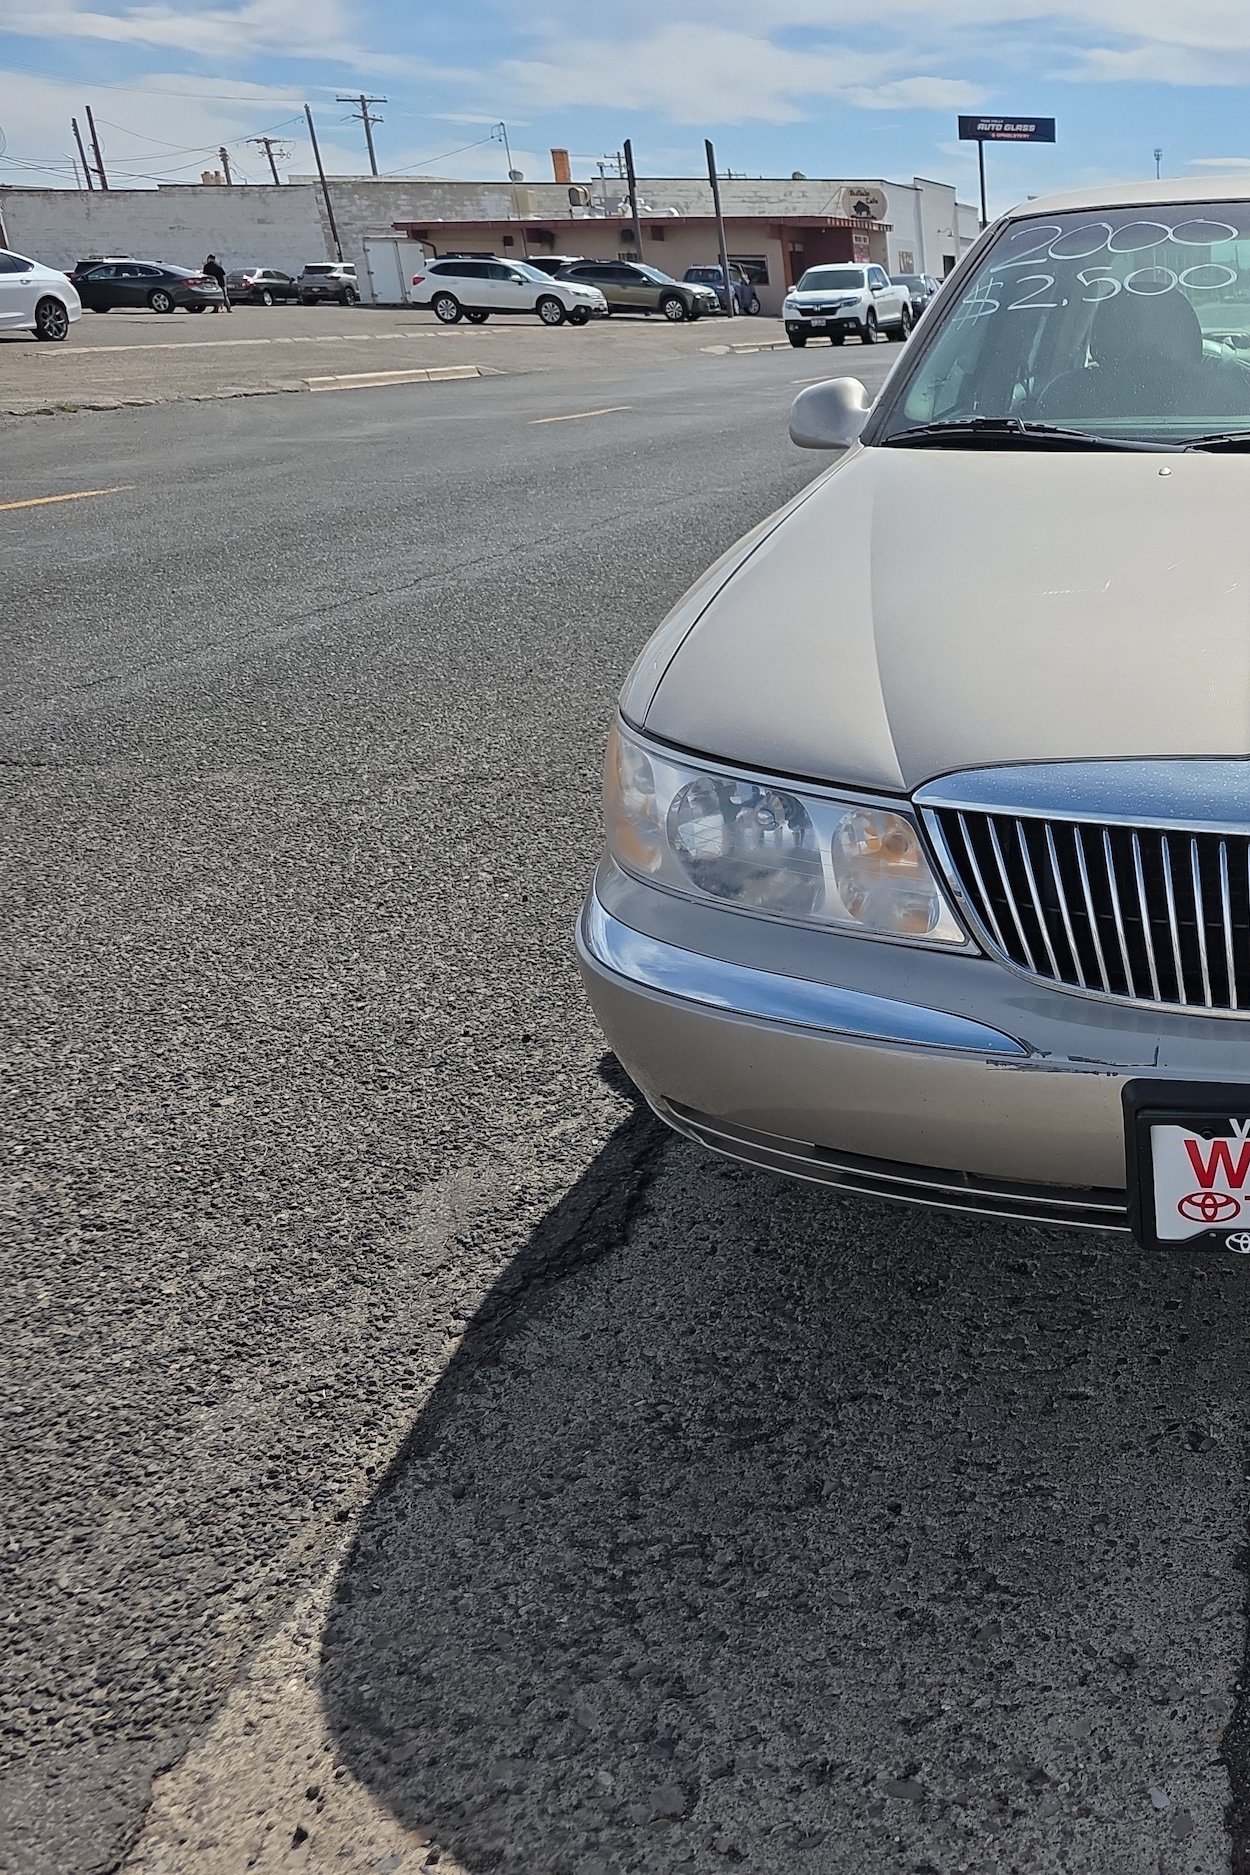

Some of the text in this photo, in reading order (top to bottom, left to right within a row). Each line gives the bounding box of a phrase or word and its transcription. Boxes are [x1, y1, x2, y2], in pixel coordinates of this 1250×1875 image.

[977, 123, 1036, 132] AUTO GLASS
[989, 218, 1239, 273] 2000
